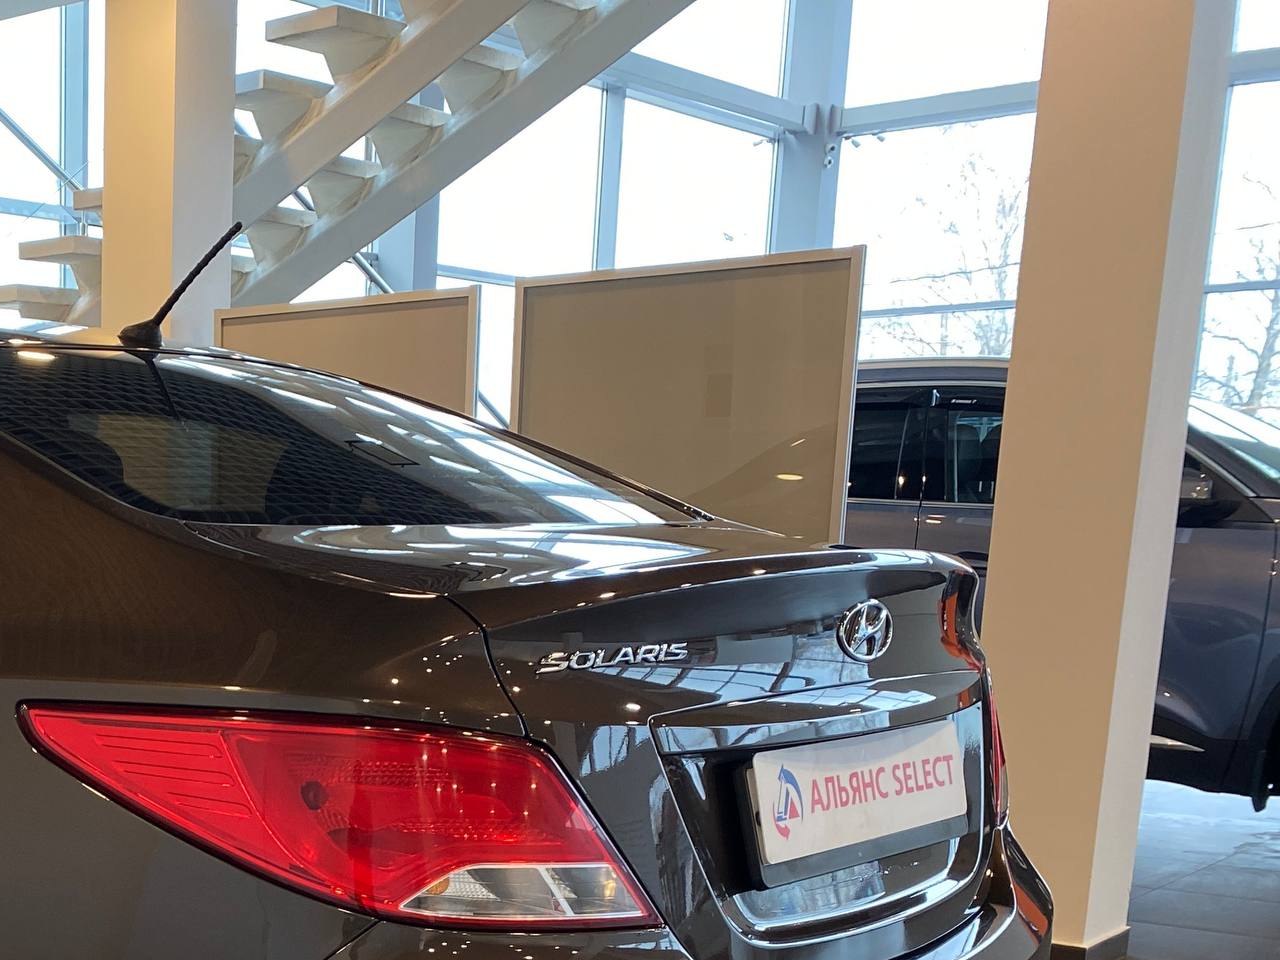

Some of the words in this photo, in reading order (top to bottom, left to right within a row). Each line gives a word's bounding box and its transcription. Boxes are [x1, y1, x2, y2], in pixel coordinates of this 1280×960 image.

[536, 642, 688, 674] SOLARIS
[811, 766, 889, 813] АЛЬЯНС
[892, 755, 954, 796] SELECT
